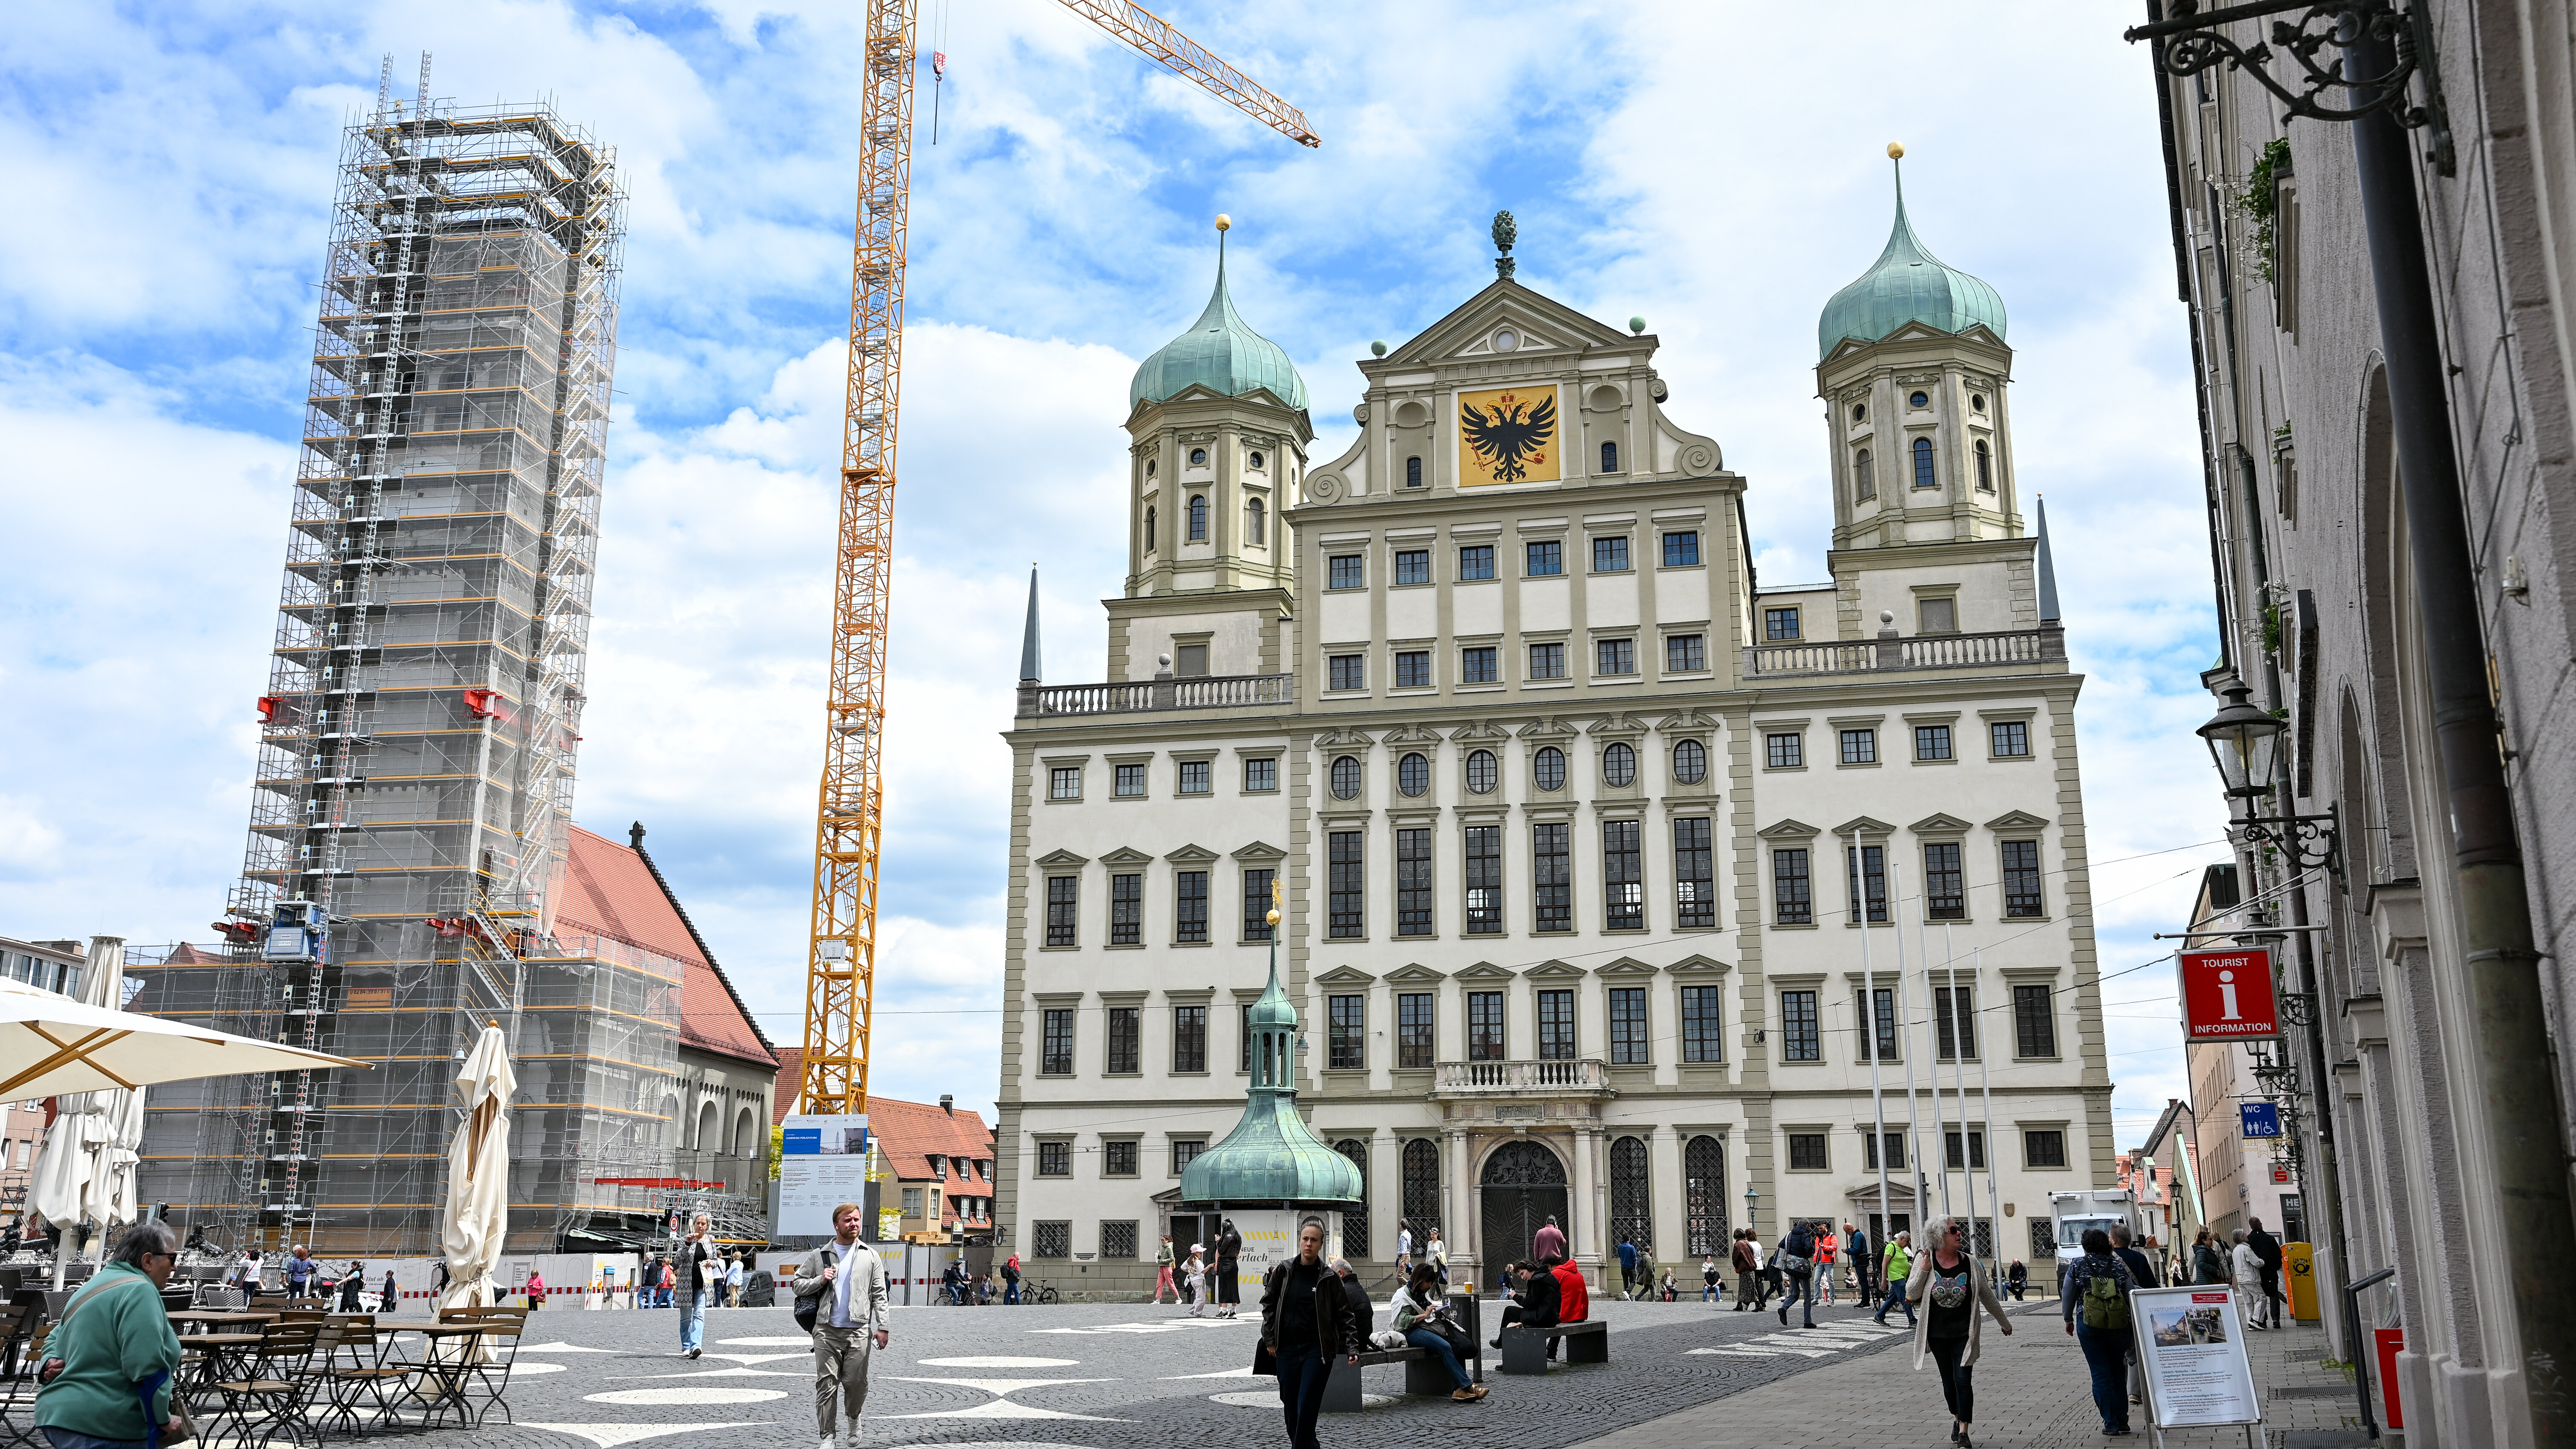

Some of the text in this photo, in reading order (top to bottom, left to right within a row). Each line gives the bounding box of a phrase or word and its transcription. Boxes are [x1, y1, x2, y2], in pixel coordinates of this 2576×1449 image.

[2202, 958, 2248, 967] TOURIST
[2195, 1023, 2271, 1033] INFORMATION
[1239, 1253, 1268, 1262] rlach
